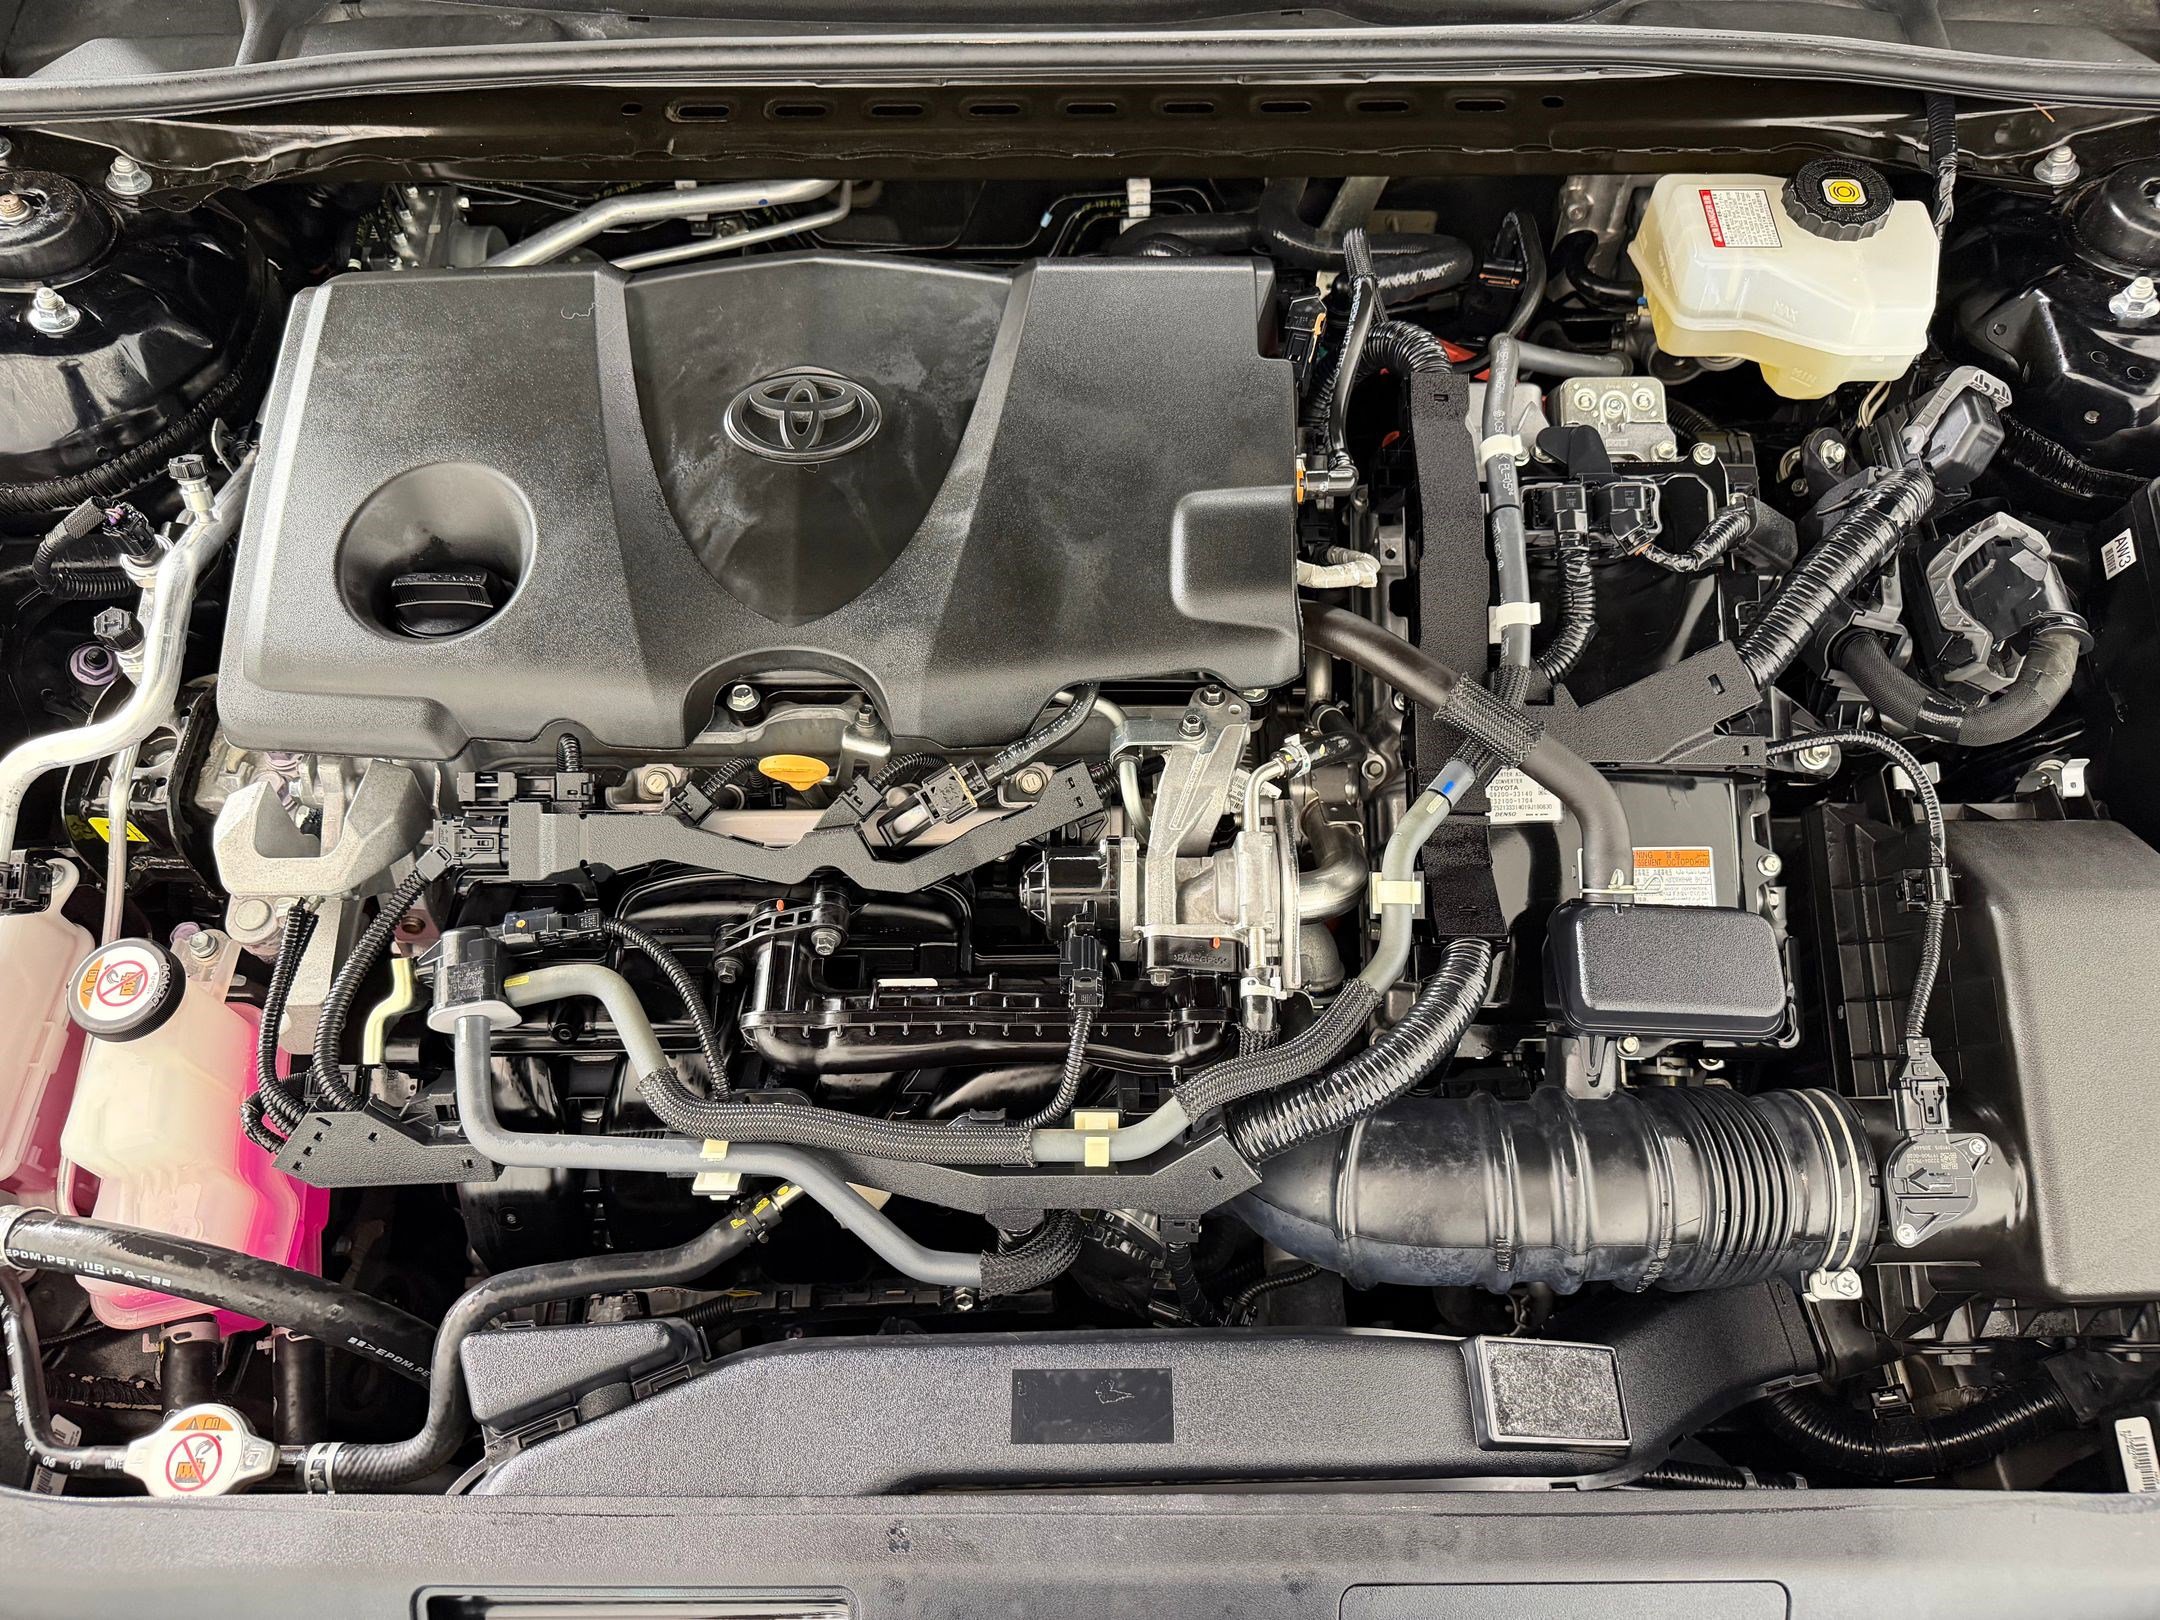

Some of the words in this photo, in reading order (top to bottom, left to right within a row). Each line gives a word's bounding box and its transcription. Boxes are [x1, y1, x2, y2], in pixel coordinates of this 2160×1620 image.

[1703, 203, 1720, 229] DANGER
[2115, 536, 2132, 568] AW3
[151, 963, 170, 1007] DENSO
[69, 1459, 82, 1470] 19
